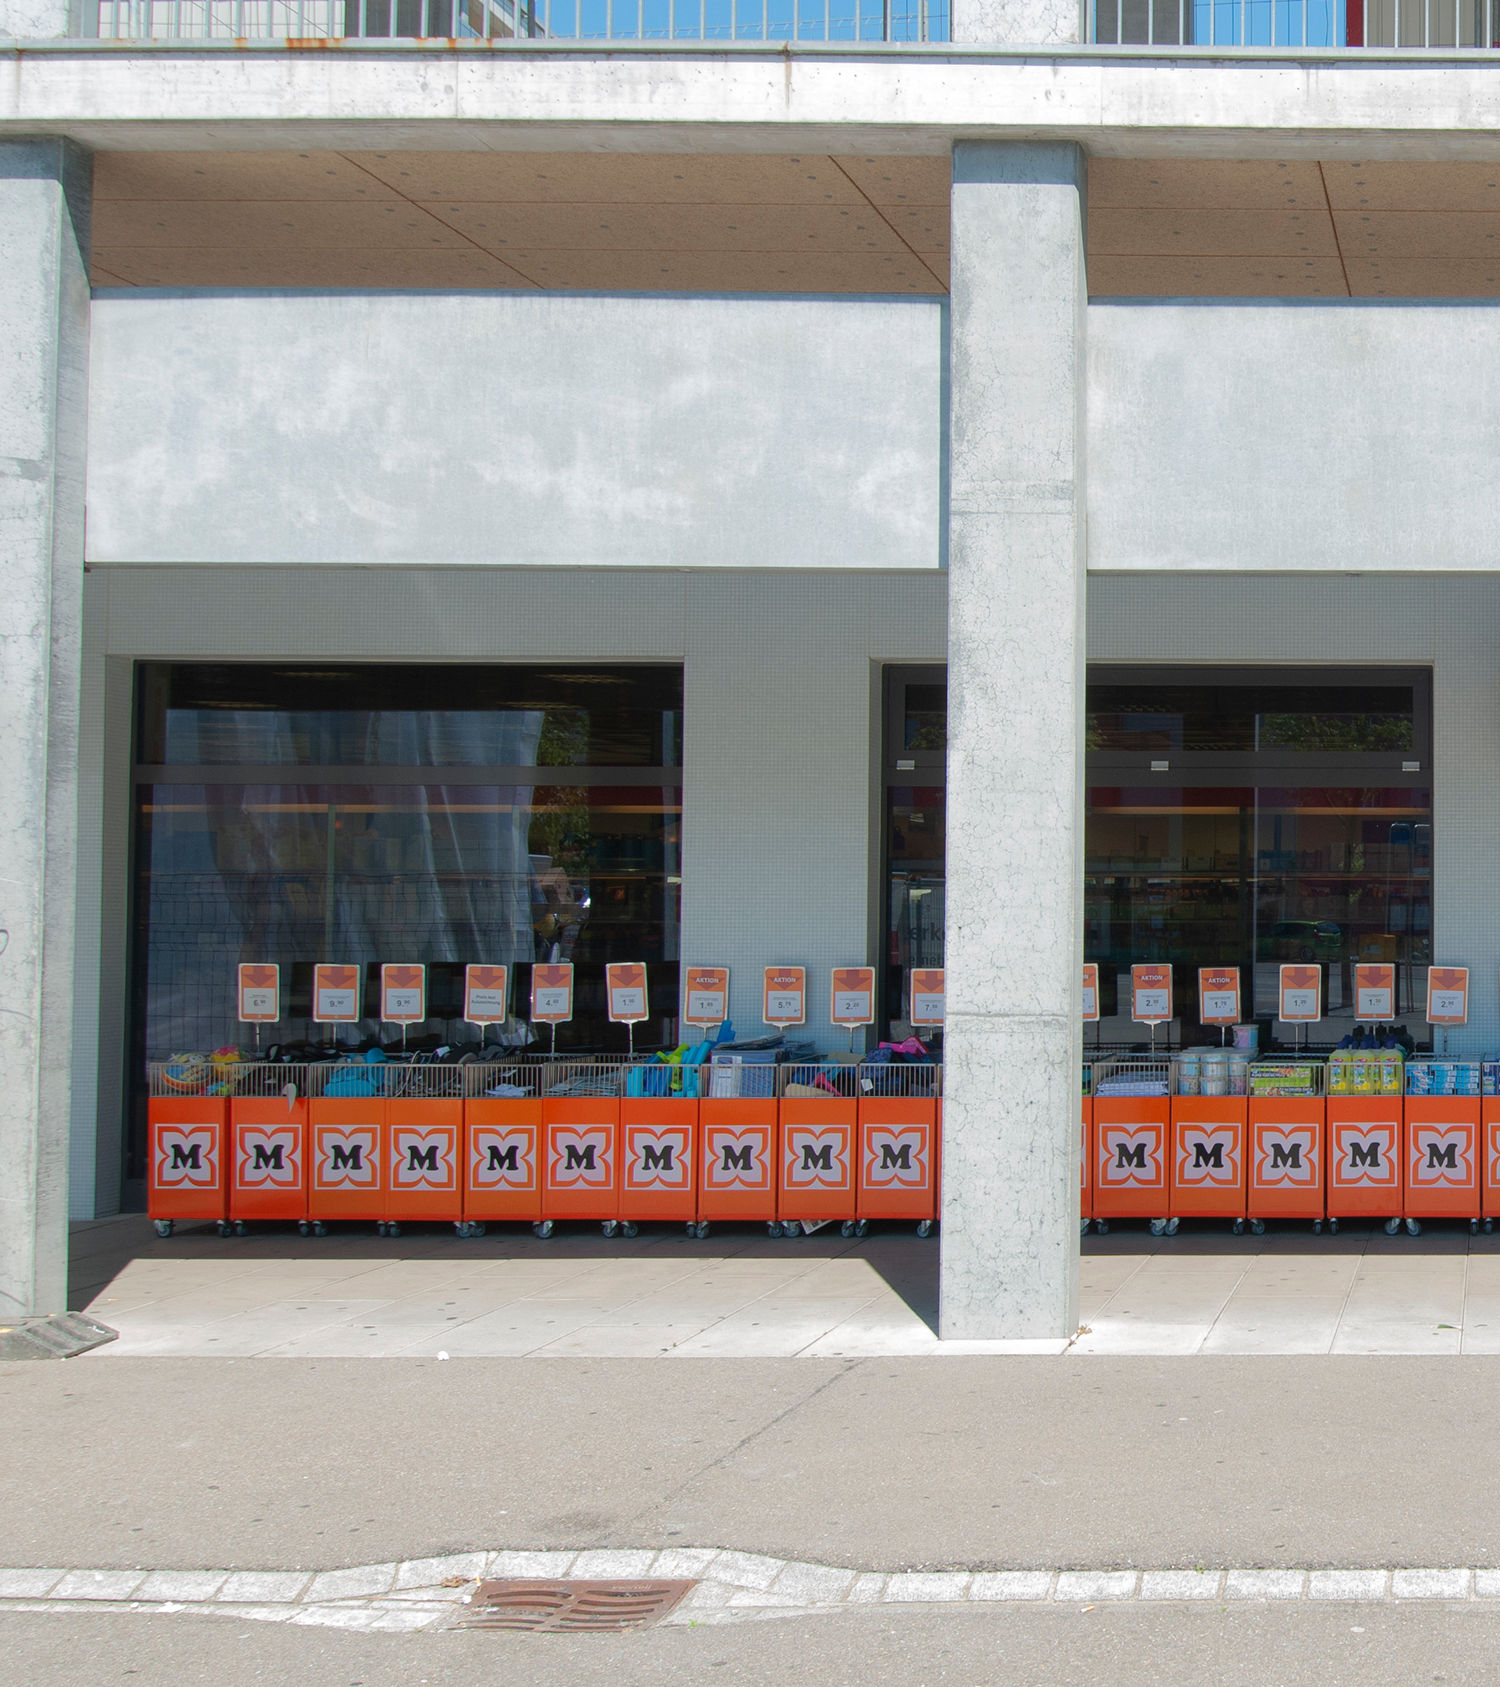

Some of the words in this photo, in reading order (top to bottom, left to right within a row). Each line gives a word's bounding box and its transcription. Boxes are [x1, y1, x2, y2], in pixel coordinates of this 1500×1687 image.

[171, 1144, 201, 1169] M
[253, 1145, 284, 1169] M
[332, 1145, 362, 1170] M
[408, 1146, 438, 1170] M
[487, 1146, 518, 1170] M
[565, 1145, 596, 1170] M
[642, 1145, 673, 1170] M
[722, 1146, 753, 1170] M
[802, 1145, 832, 1170] M
[880, 1144, 911, 1169] M
[1116, 1144, 1146, 1168] M
[1193, 1143, 1223, 1168] M
[1271, 1144, 1301, 1168] M
[1350, 1143, 1380, 1167] M
[1427, 1144, 1457, 1168] M
